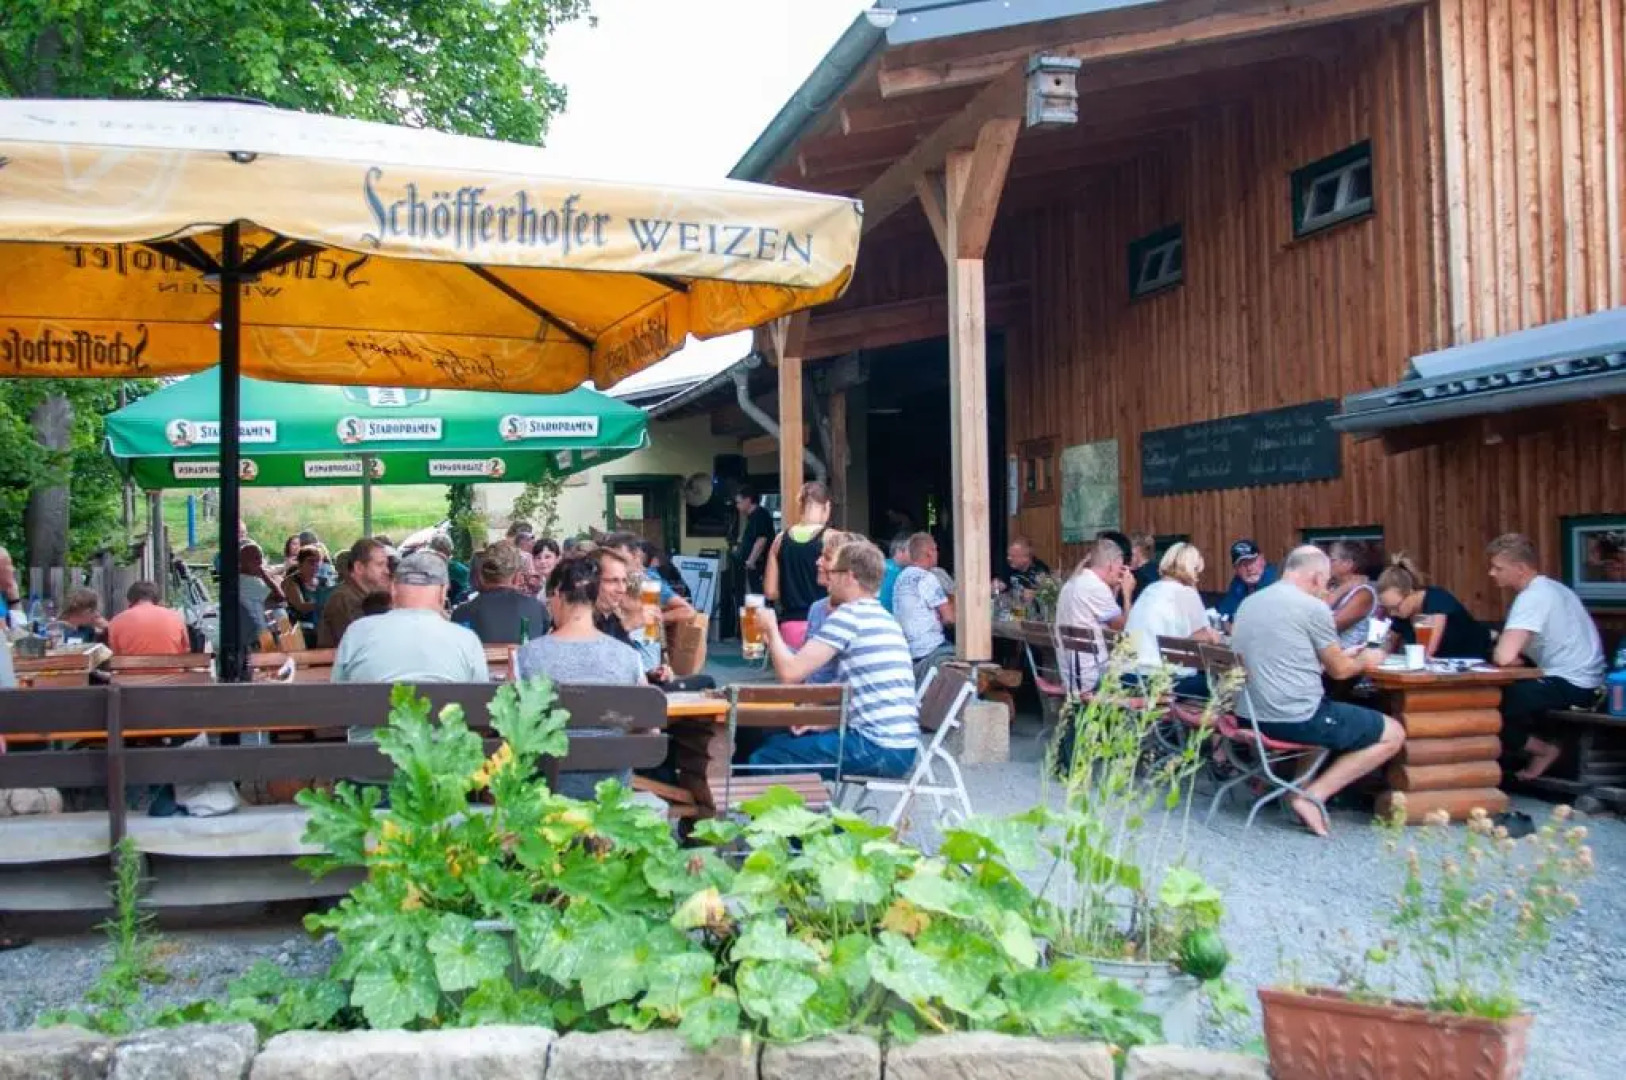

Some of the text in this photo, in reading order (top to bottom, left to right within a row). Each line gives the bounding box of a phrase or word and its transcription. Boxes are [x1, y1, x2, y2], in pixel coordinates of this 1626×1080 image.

[362, 166, 815, 265] Schöfferhofer WEIZEN
[200, 425, 271, 438] STARAMEN
